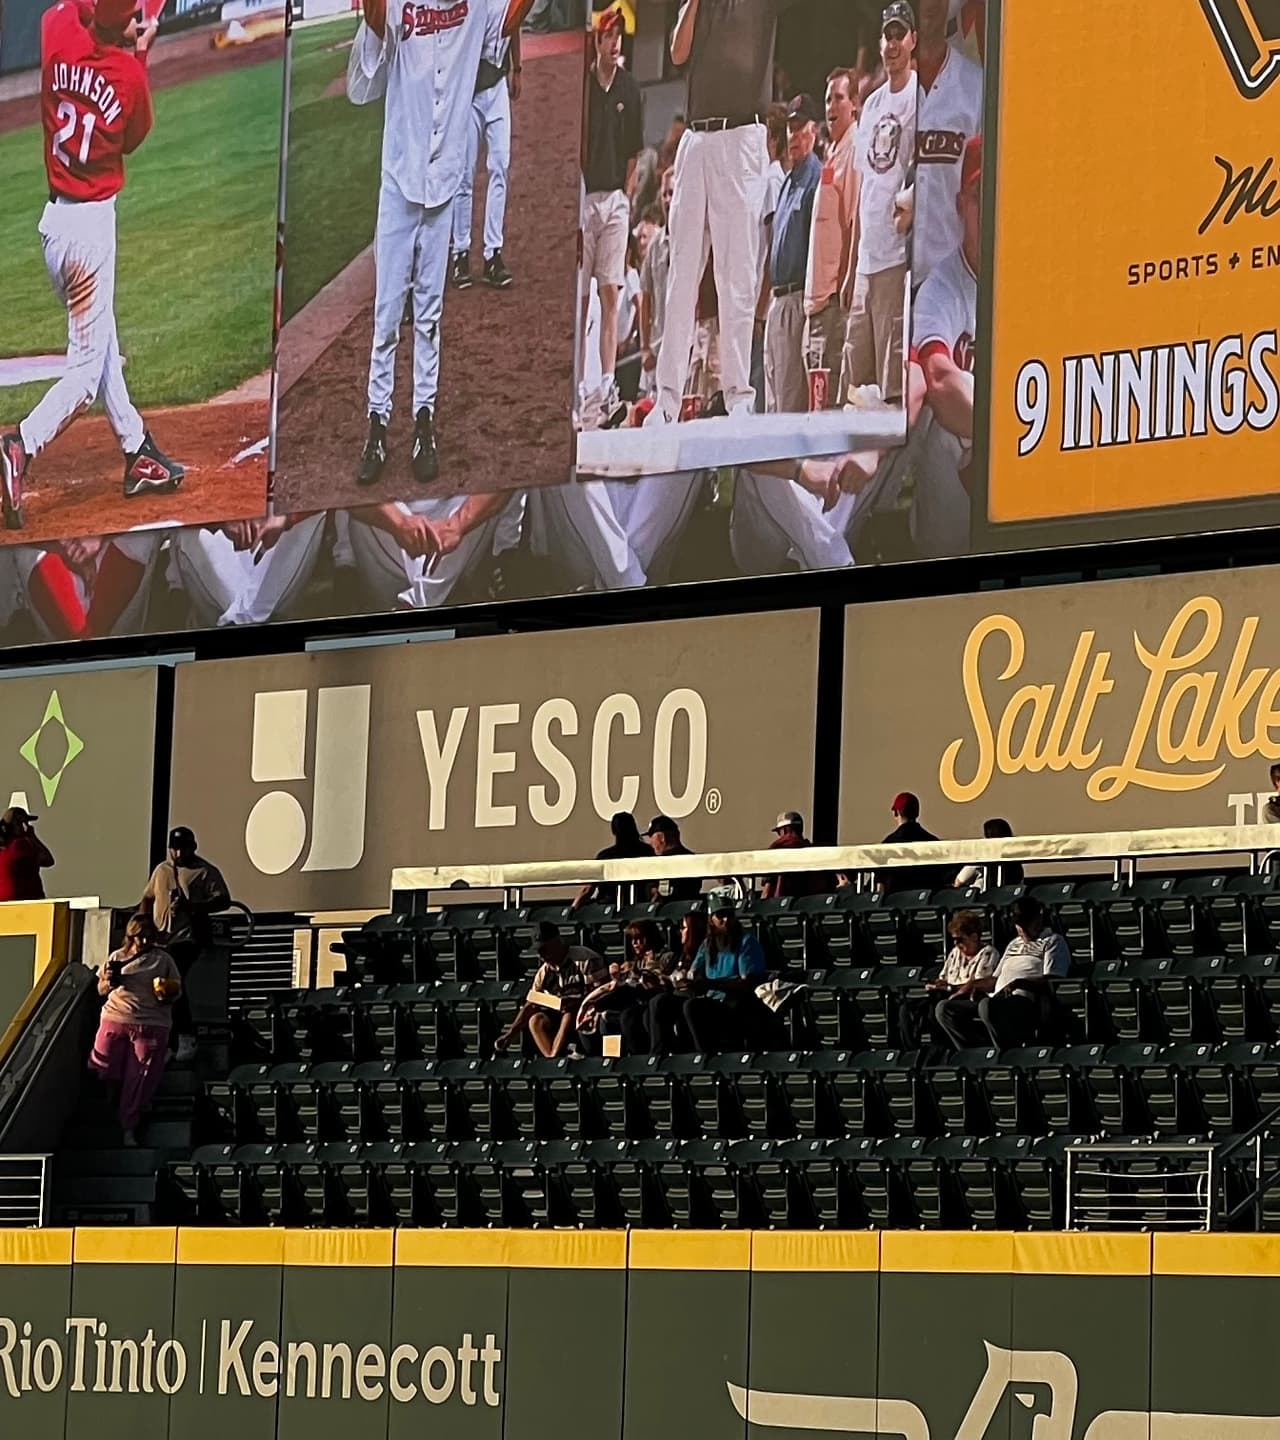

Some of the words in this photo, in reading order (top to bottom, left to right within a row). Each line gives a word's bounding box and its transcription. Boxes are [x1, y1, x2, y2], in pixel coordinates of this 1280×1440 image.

[52, 62, 122, 126] JOHNSON
[52, 101, 97, 168] 21
[1126, 254, 1219, 286] SPORTS
[1014, 359, 1048, 458] 9
[1059, 326, 1280, 452] INNINGS
[937, 614, 1115, 803] Salt
[218, 1319, 503, 1407] Kennecott
